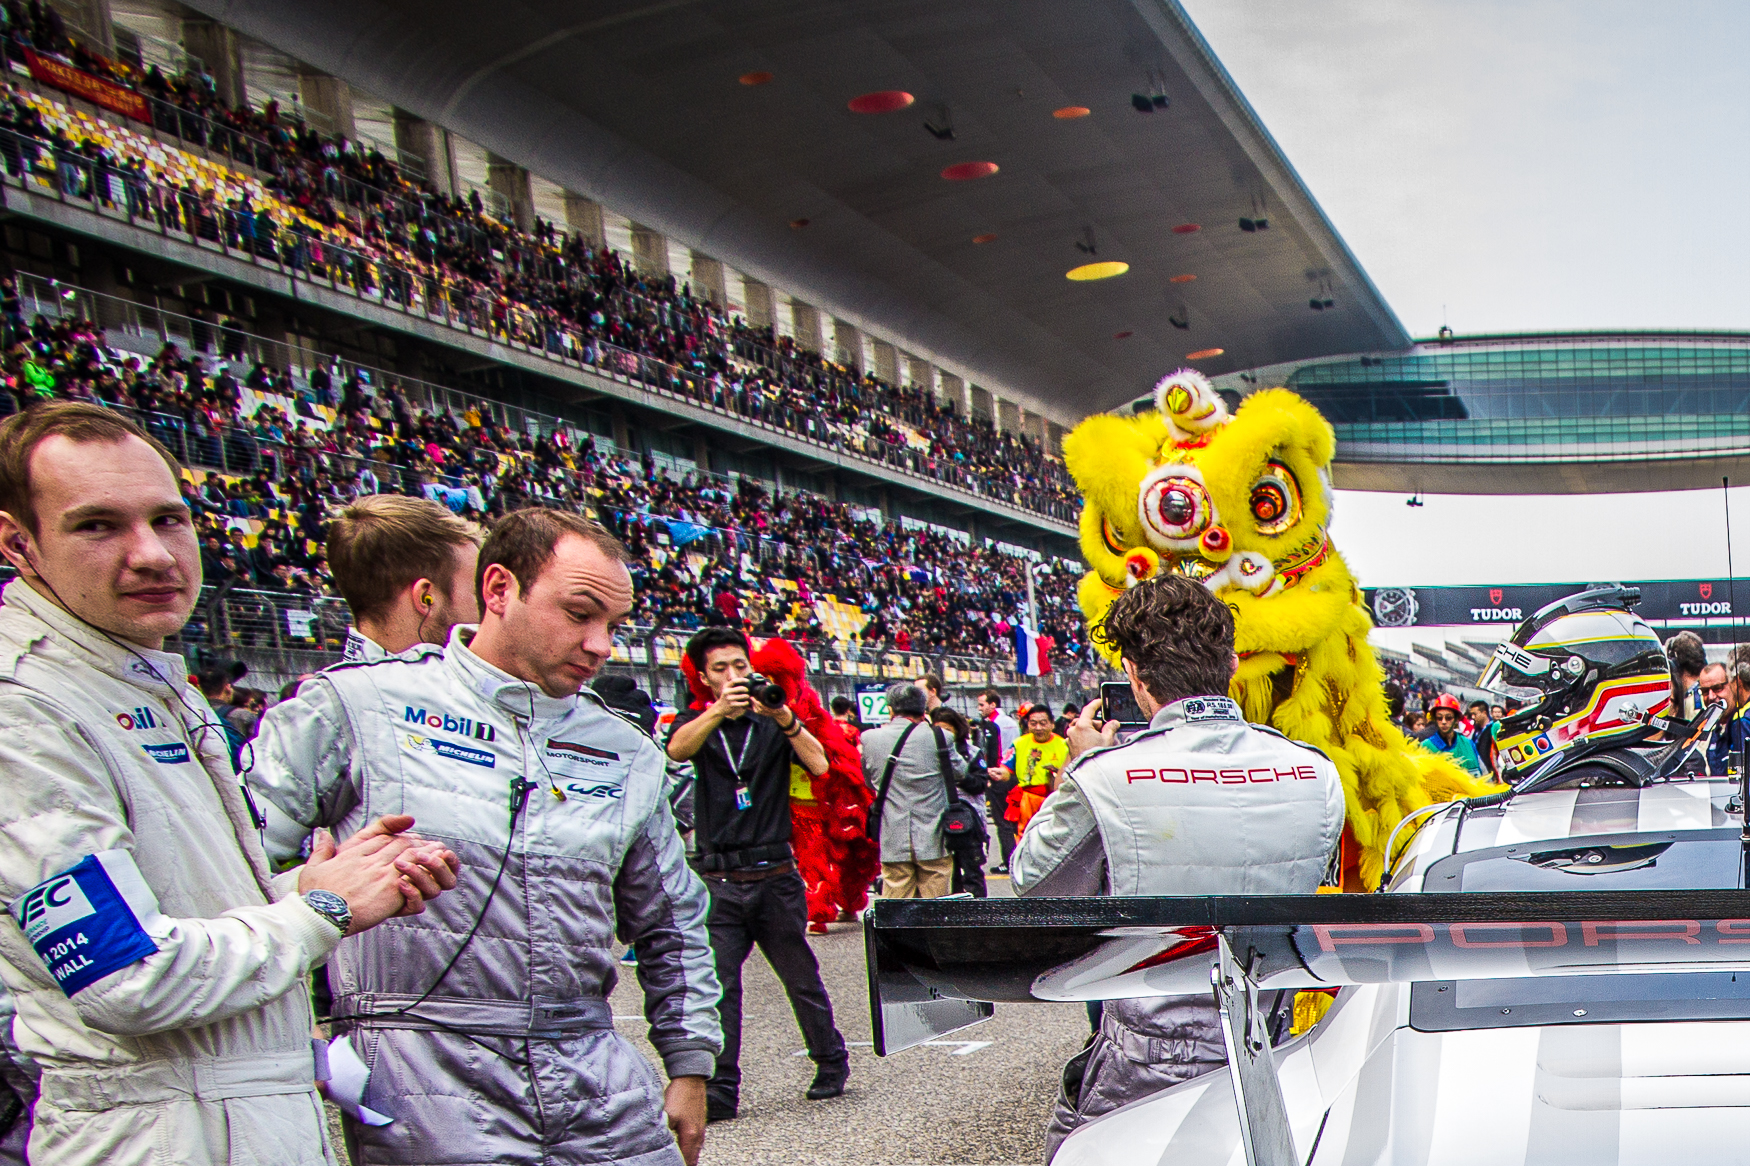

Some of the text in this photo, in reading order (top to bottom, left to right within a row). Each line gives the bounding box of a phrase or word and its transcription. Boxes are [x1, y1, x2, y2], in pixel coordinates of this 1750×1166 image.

[1470, 608, 1523, 621] TUDOR
[1680, 602, 1732, 615] TUDOR
[862, 696, 889, 715] 92
[404, 706, 472, 737] Mobil
[437, 744, 494, 763] MICHELIN
[546, 752, 609, 767] MOTORSPORT
[1126, 766, 1318, 785] PORSCHE
[567, 784, 622, 799] WEC
[49, 933, 89, 960] 2014
